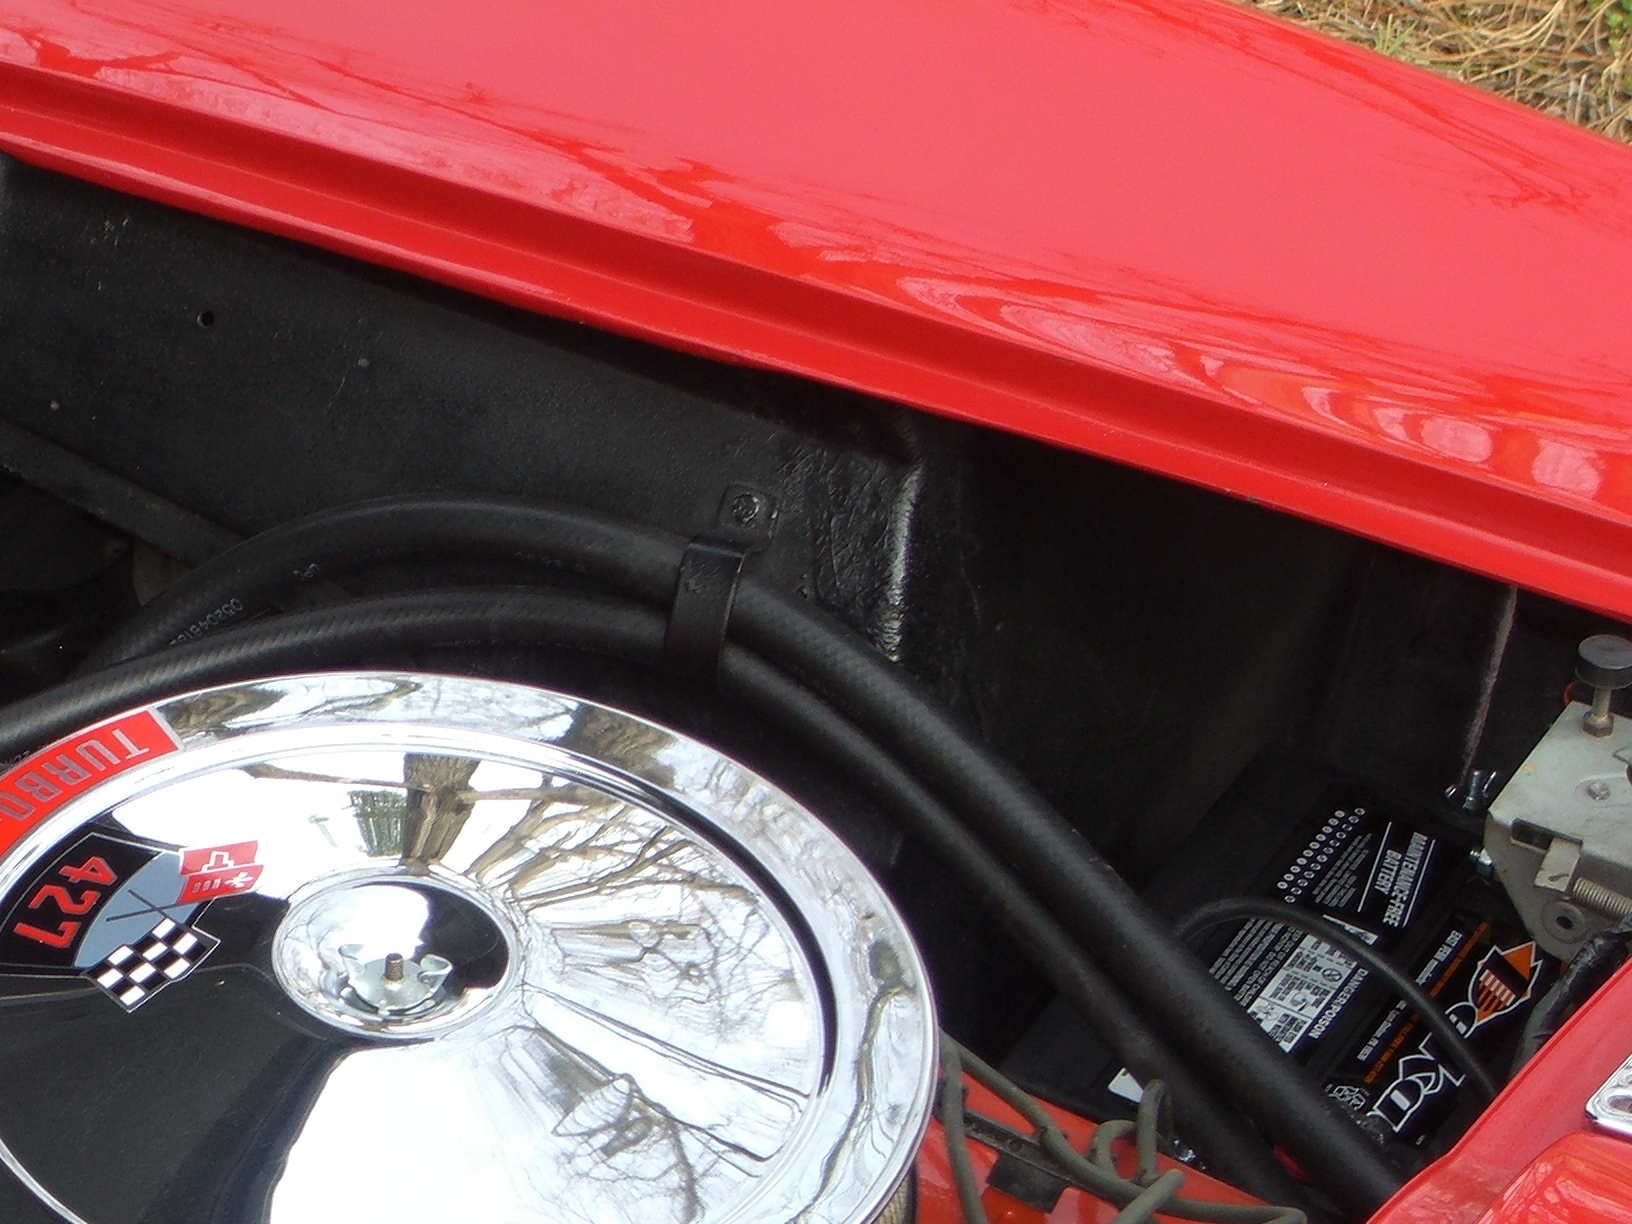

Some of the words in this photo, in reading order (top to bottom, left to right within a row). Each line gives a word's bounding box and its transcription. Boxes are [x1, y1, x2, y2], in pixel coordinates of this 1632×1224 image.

[14, 856, 117, 950] 427
[1374, 849, 1402, 895] BATTERY
[1382, 832, 1427, 927] MAINTENANCE-FREE
[1307, 968, 1369, 1040] DANGER/POISON
